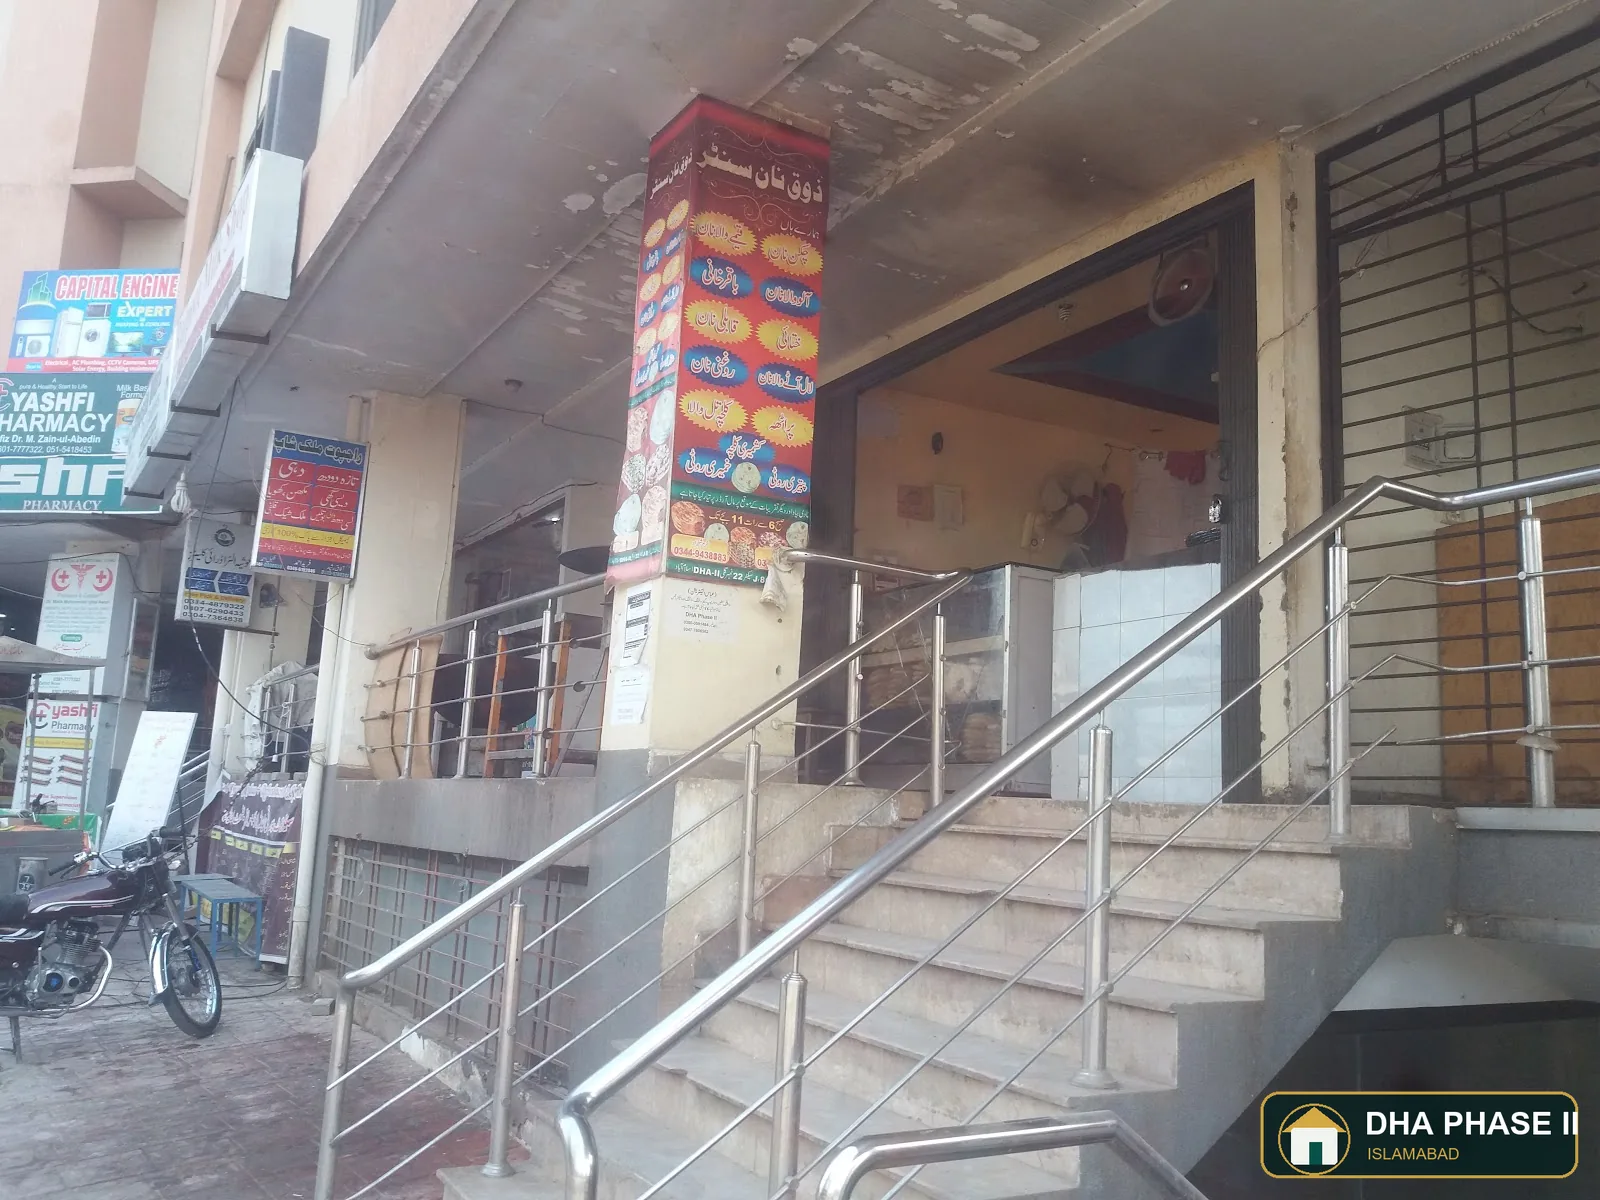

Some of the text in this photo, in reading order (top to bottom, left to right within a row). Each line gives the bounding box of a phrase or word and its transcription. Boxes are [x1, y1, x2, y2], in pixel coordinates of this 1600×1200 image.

[696, 143, 823, 203] ذوق نان سنٹر
[697, 223, 715, 237] نان
[768, 243, 811, 265] چکن نان
[55, 275, 119, 300] CAPITAL
[765, 286, 785, 302] نان
[117, 301, 174, 318] EXPERT
[696, 312, 716, 327] نان
[691, 356, 711, 373] نان
[711, 351, 735, 378] روغنی
[758, 371, 773, 385] نان
[116, 384, 133, 392] Milk
[12, 392, 95, 412] YASHFI
[688, 400, 704, 415] والا
[38, 435, 101, 443] Zain-ul-Abedin
[273, 435, 363, 465] راجپوت ملک شاپ
[685, 448, 707, 473] روٹی
[279, 462, 305, 478] دہی
[768, 467, 787, 488] روٹی
[340, 475, 359, 486] تازہ
[23, 500, 102, 511] PHARMACY
[731, 514, 743, 525] 11
[768, 520, 775, 530] 6
[693, 566, 720, 578] DHA-II
[733, 572, 743, 581] 22
